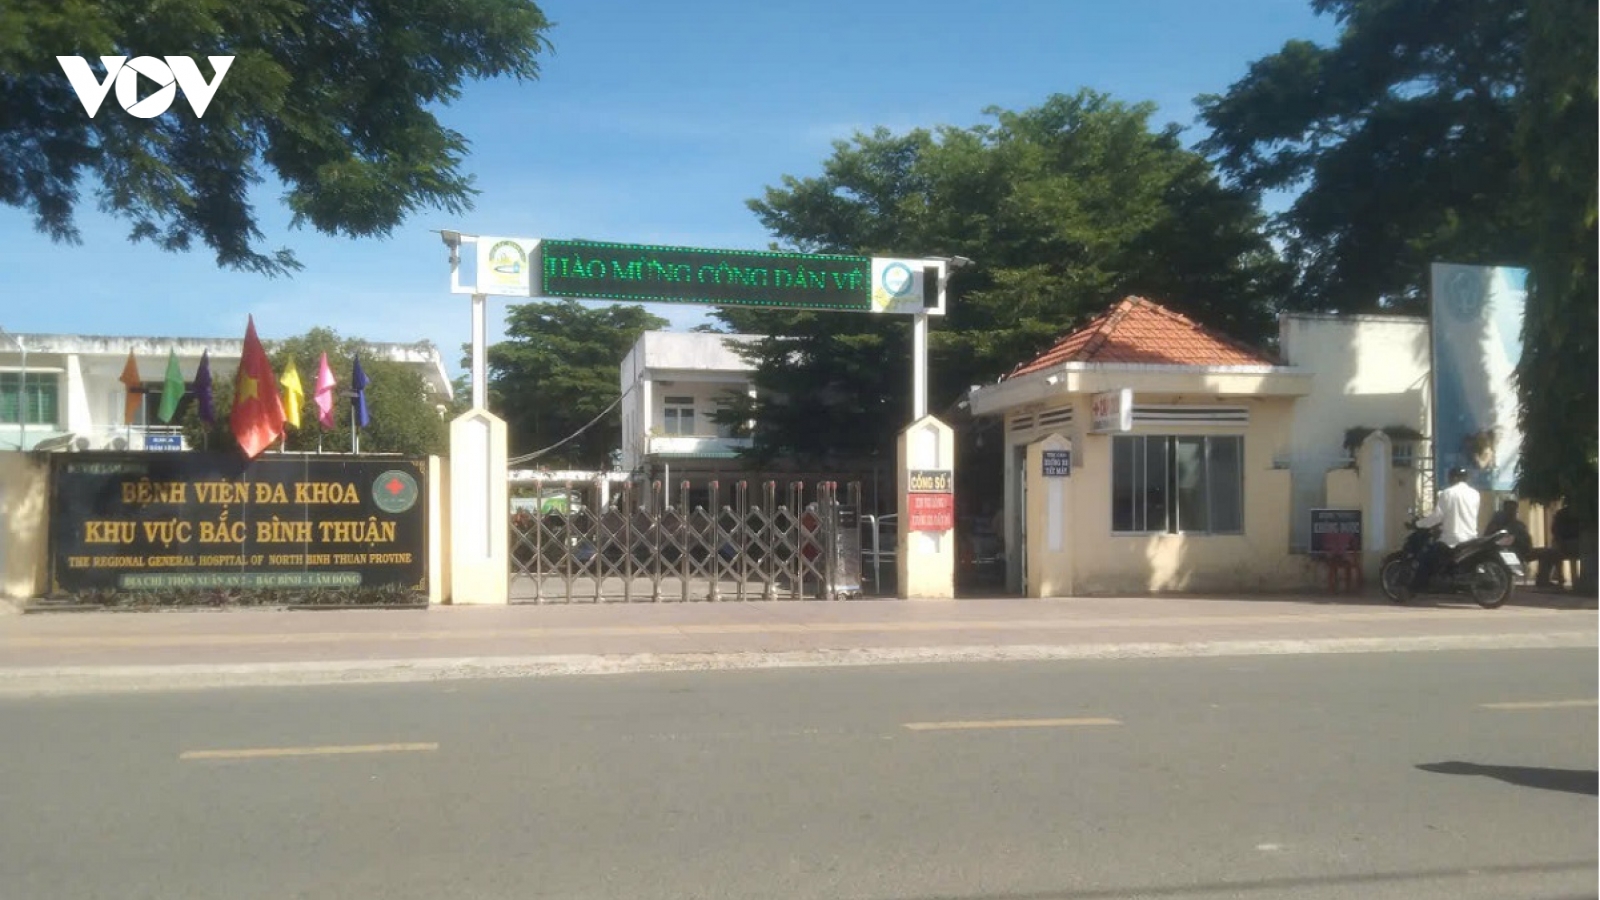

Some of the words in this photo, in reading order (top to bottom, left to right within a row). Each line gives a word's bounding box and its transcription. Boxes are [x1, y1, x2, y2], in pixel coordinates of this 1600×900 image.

[121, 477, 187, 508] BỆNH
[194, 478, 250, 509] VIỆN
[255, 482, 289, 504] ĐA
[294, 482, 360, 504] KHOA
[84, 521, 136, 544] KHU
[143, 517, 192, 548] VỰC
[199, 509, 246, 544] BẮC
[256, 515, 313, 543] BÌNH
[318, 515, 396, 547] THUẬN
[69, 556, 90, 567] THE
[92, 556, 145, 567] REGIONAL
[148, 555, 195, 567] GENERAL
[199, 554, 248, 566] HOSPITAL
[251, 554, 264, 566] OF
[269, 554, 303, 565] NORTH
[306, 553, 330, 565] BINH
[333, 553, 367, 564] THUAN
[369, 552, 412, 564] PROVINE
